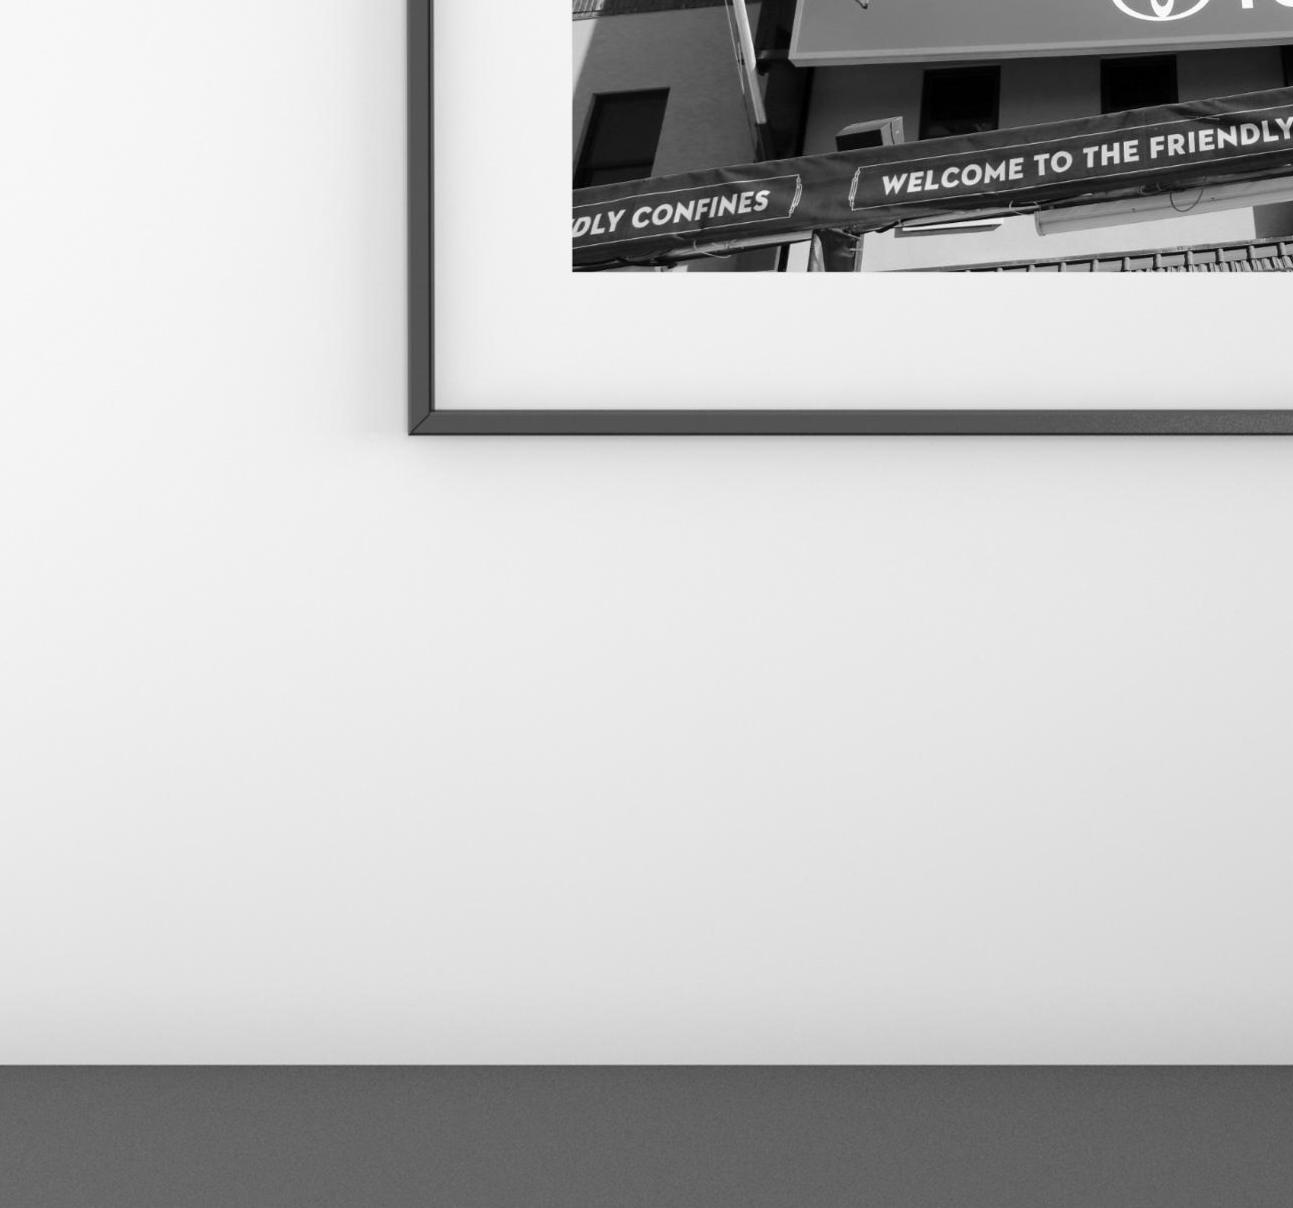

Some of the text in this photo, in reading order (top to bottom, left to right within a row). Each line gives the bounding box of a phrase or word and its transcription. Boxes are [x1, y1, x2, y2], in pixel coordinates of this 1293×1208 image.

[882, 158, 1025, 196] WELCOME
[1033, 150, 1073, 177] TO
[1083, 141, 1140, 168] THE
[631, 190, 771, 229] CONFINES
